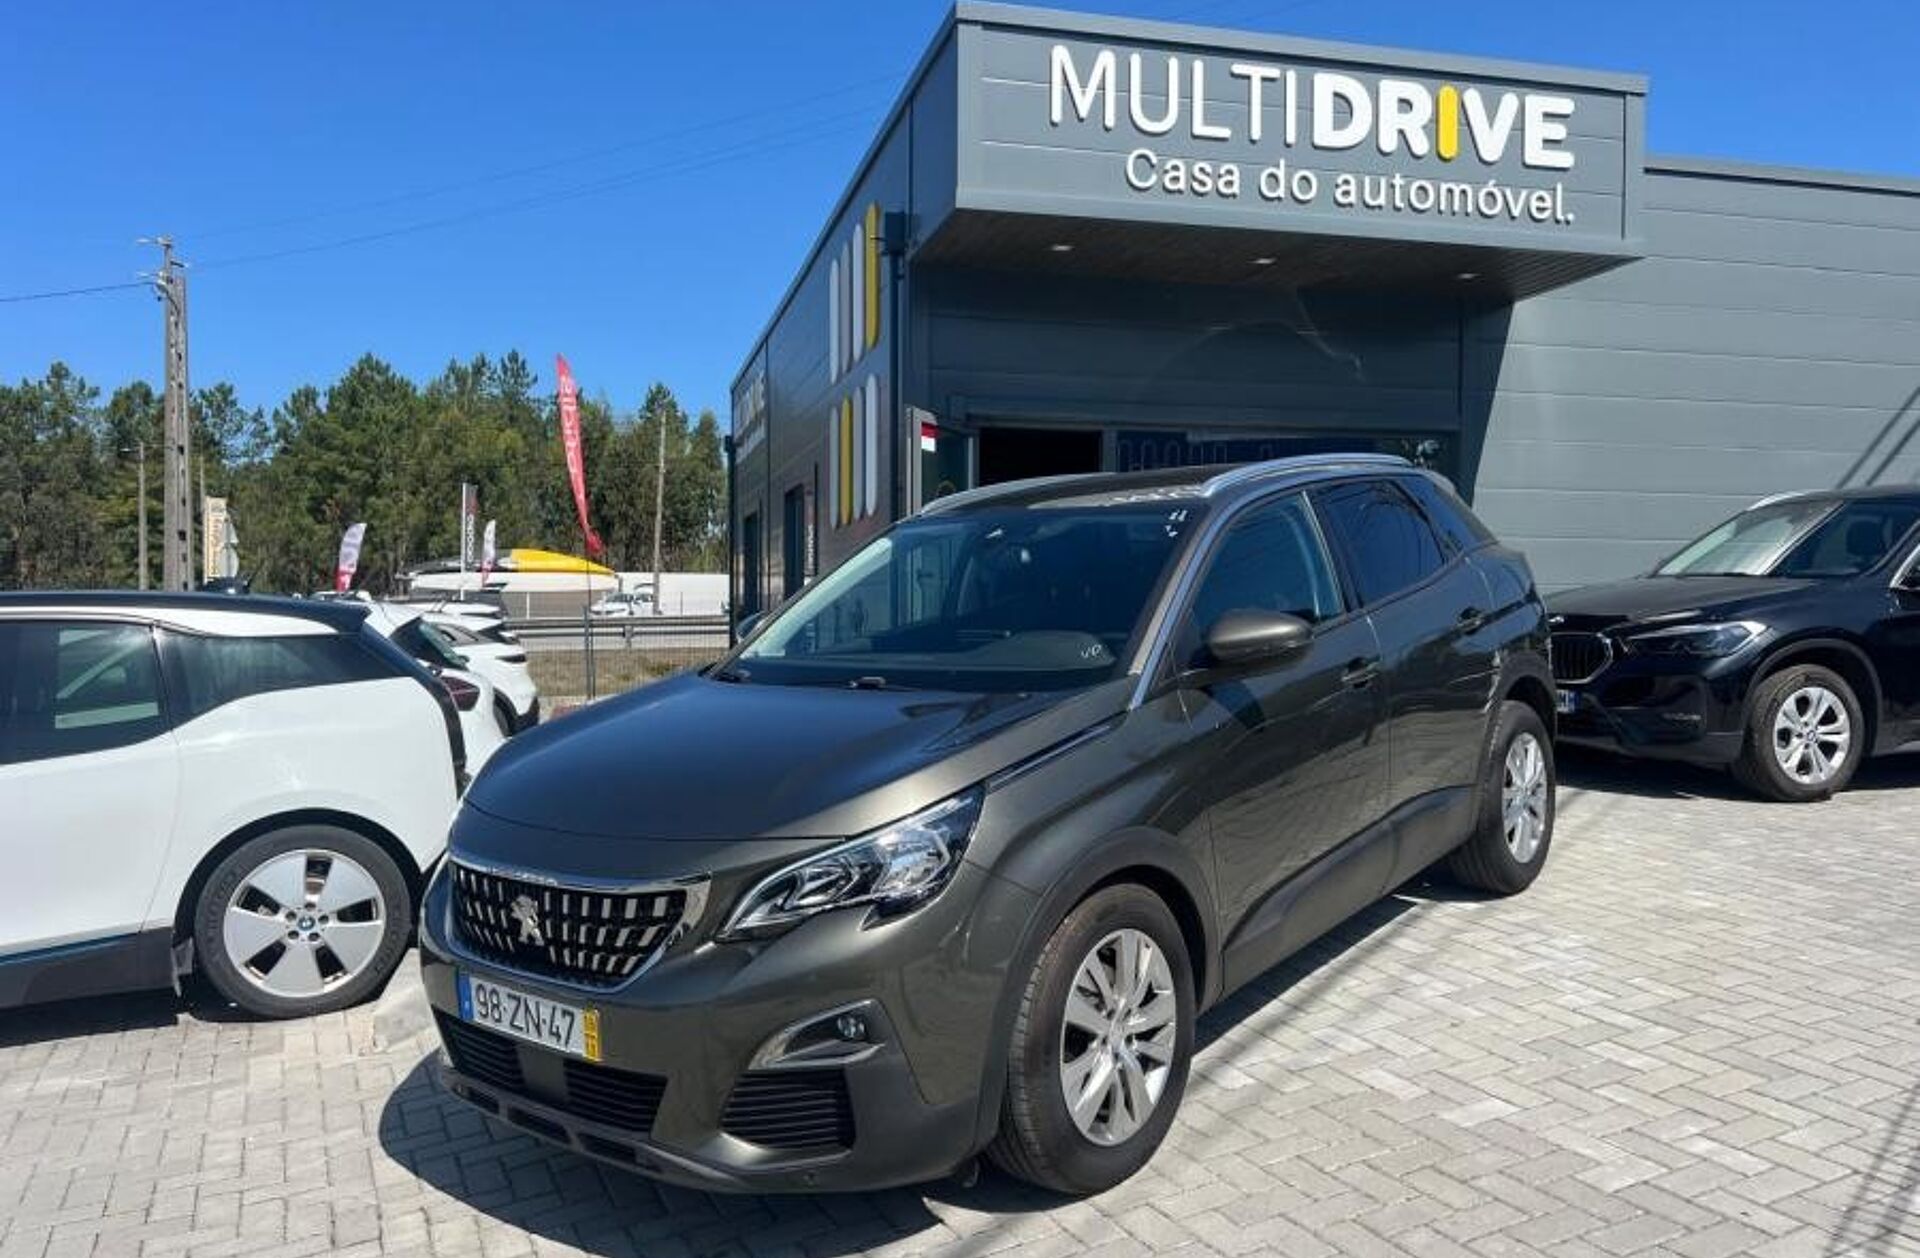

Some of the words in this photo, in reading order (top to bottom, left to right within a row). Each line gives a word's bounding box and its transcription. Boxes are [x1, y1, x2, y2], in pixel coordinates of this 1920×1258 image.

[1050, 44, 1575, 169] MULTIDRIVE
[1125, 148, 1241, 197] Casa
[1259, 159, 1318, 202] do
[1334, 171, 1575, 223] automóvel.
